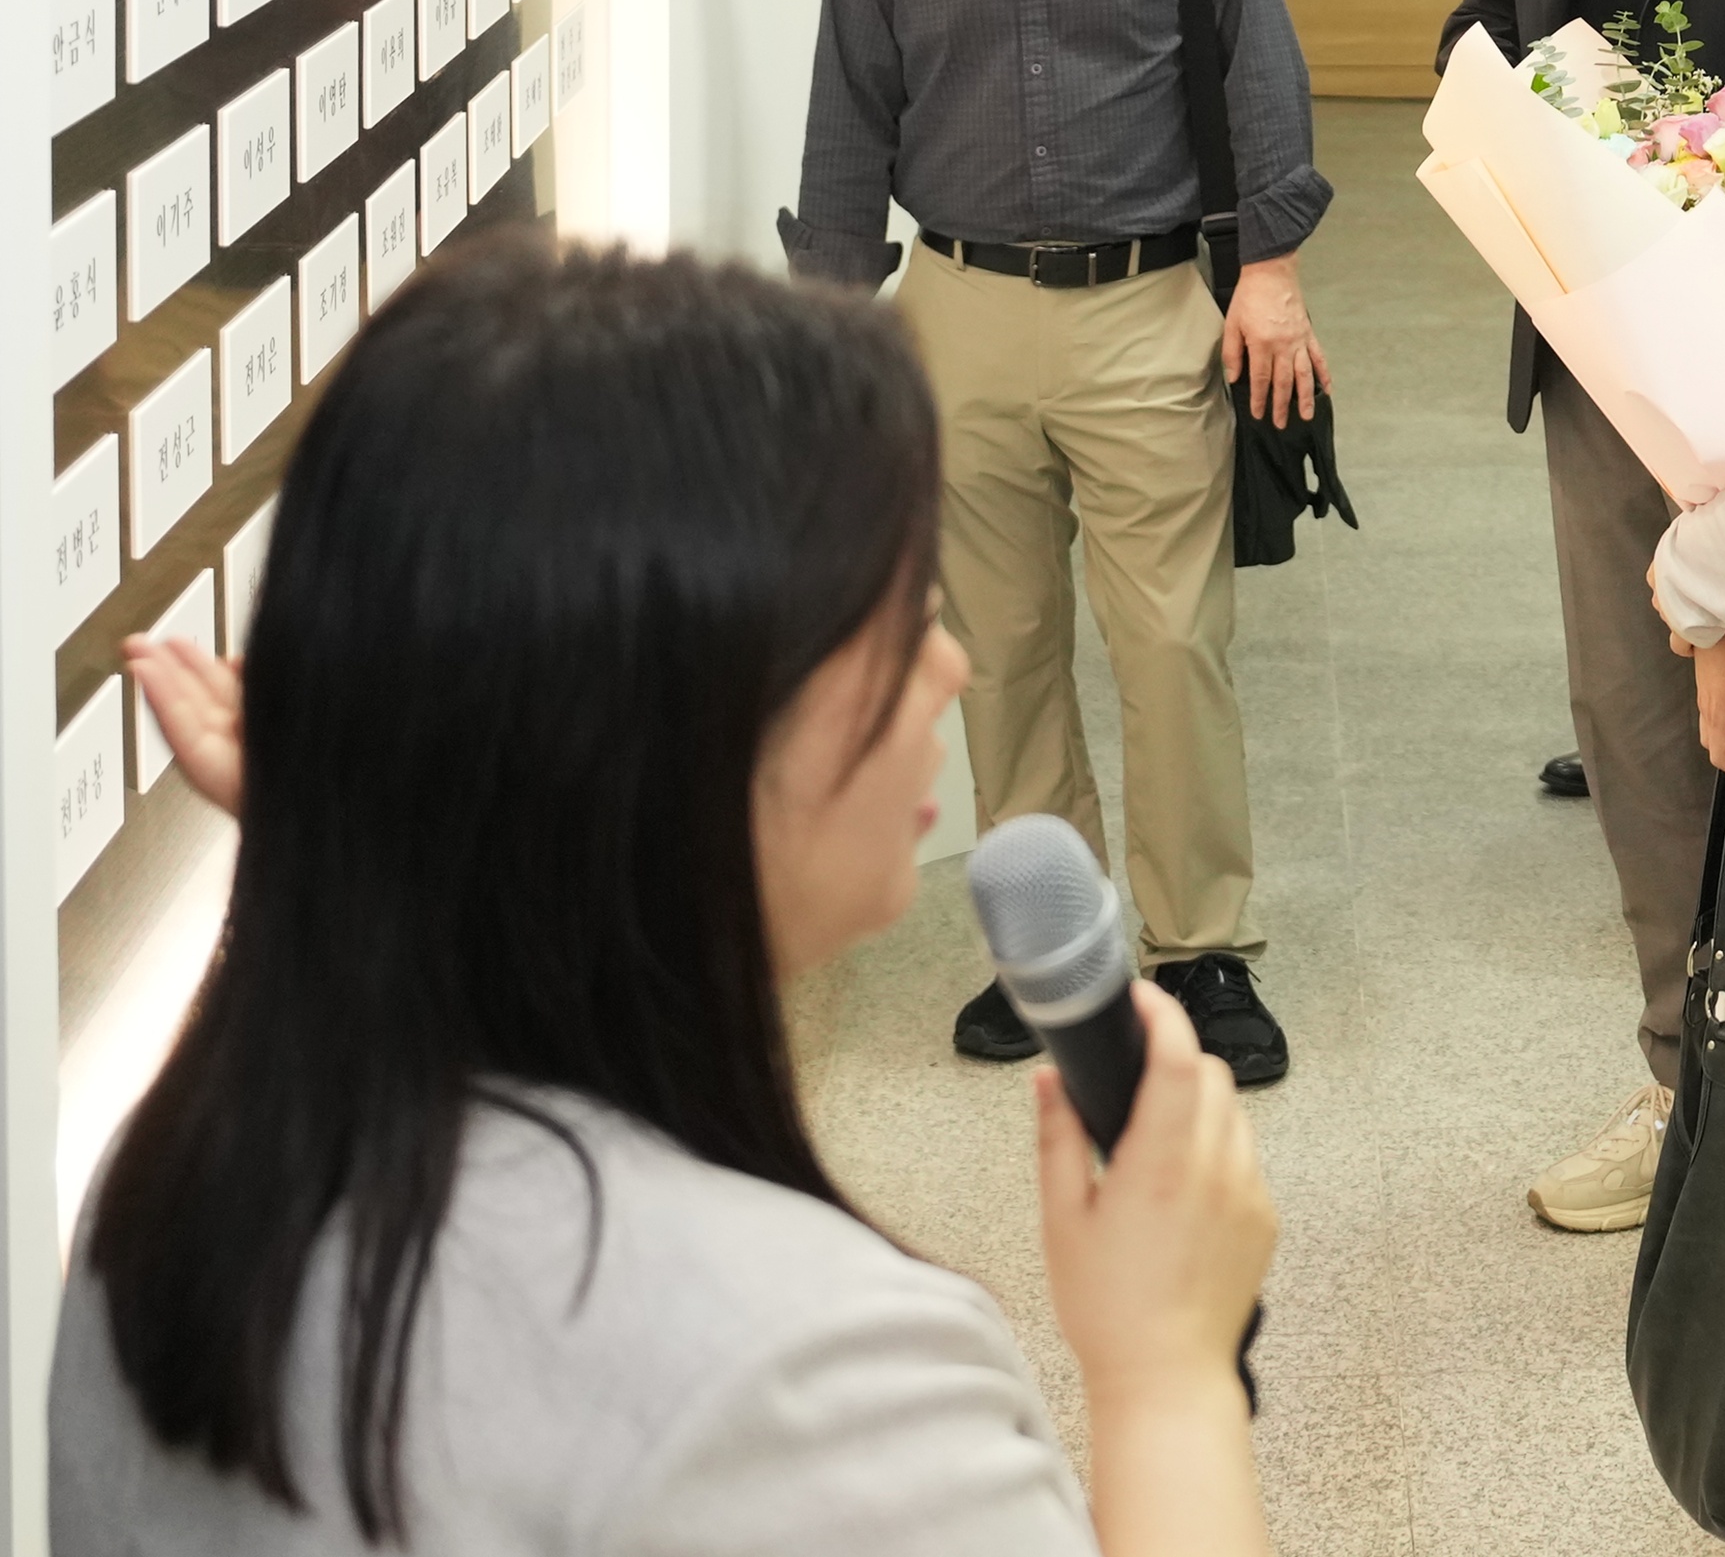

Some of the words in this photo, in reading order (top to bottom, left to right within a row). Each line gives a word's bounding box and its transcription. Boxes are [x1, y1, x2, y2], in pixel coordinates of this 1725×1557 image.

[52, 8, 96, 76] 안금식
[243, 125, 276, 180] 이성우
[156, 186, 194, 248] 이기주
[244, 336, 278, 397] 전지은
[158, 414, 196, 484] 전성근
[59, 752, 104, 840] 천한봉
